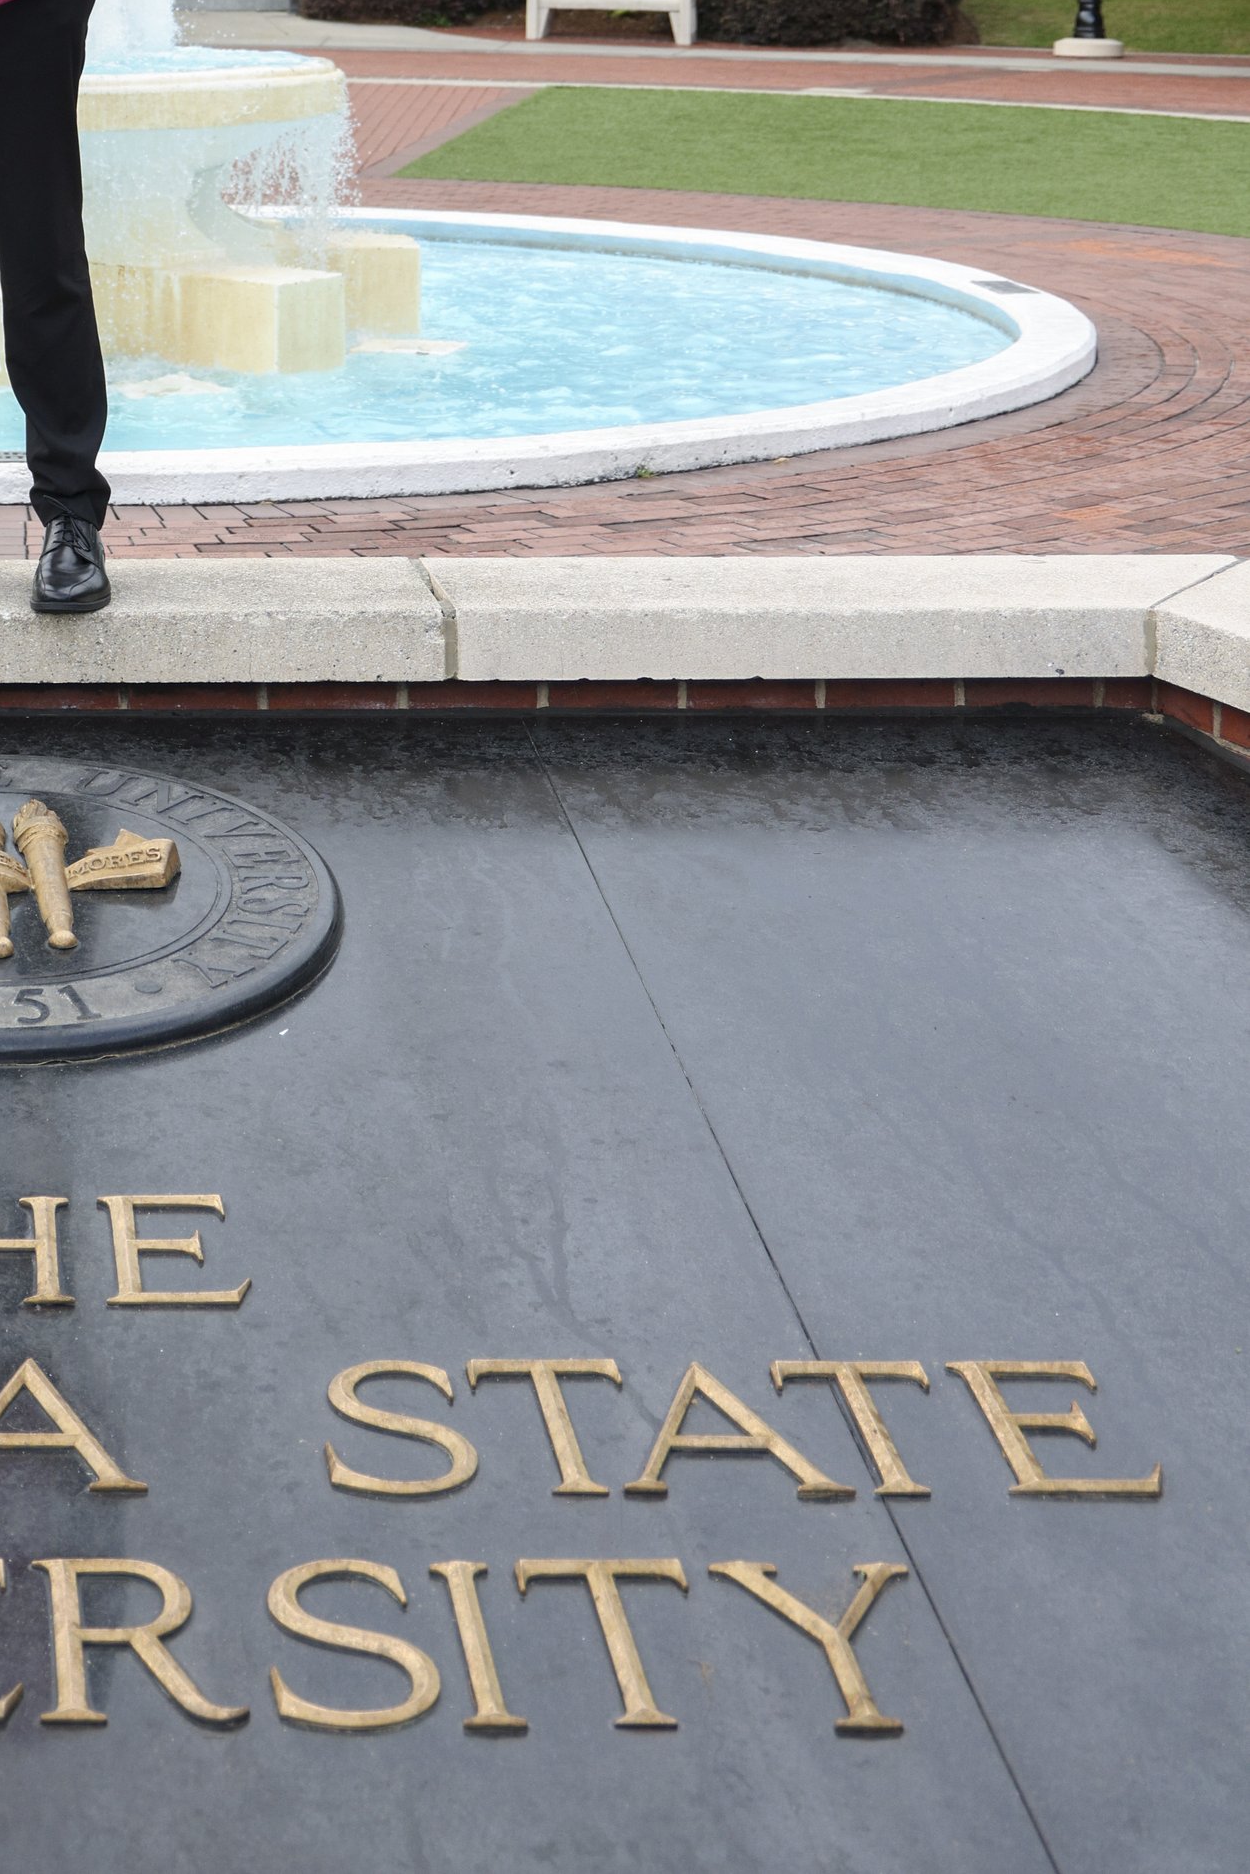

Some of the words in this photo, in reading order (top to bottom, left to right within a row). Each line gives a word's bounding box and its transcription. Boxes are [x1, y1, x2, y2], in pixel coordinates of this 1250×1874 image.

[68, 846, 163, 877] MORES
[74, 771, 310, 989] UNIVERSITY
[323, 1357, 1163, 1498] STATE
